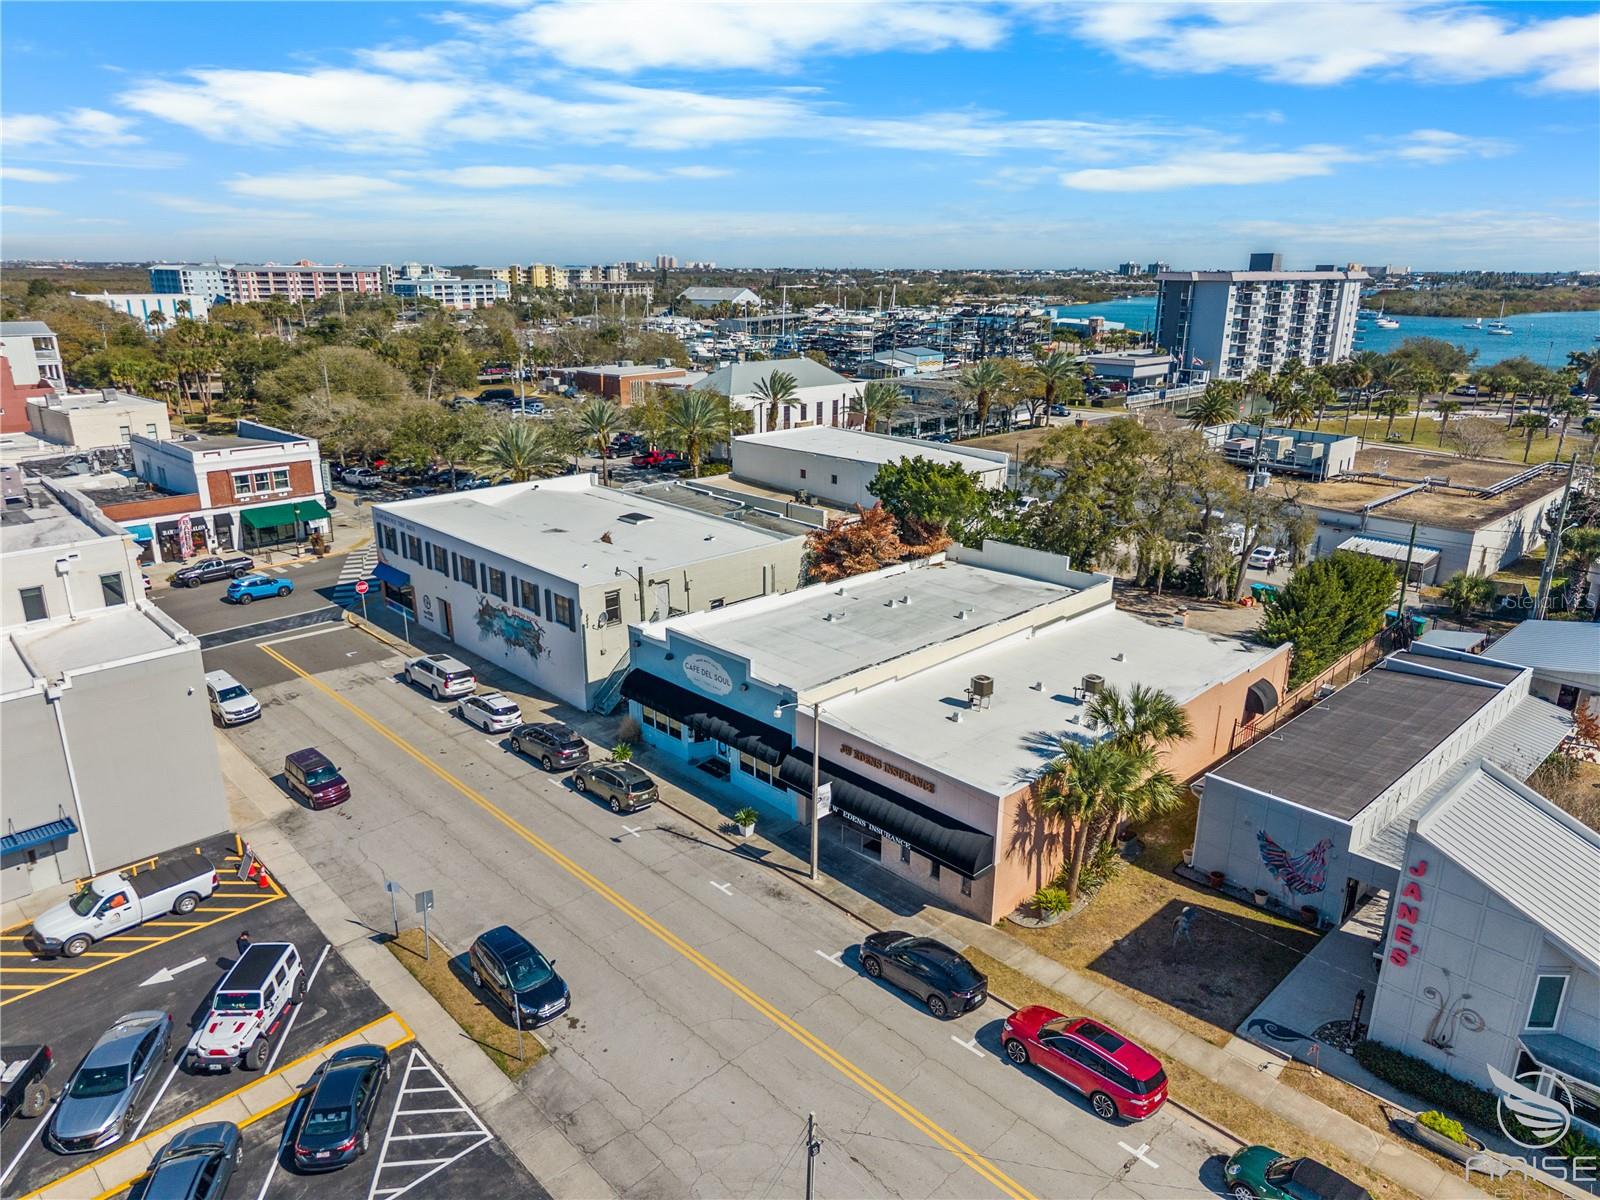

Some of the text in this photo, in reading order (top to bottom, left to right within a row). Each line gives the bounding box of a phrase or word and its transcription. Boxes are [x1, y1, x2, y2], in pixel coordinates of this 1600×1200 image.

[684, 662, 700, 674] CAFE
[701, 668, 713, 680] DEL
[714, 674, 731, 687] SOUL
[853, 749, 882, 769] EDENS
[883, 762, 936, 794] INSURANCE
[843, 810, 867, 828] EDENS
[1390, 860, 1428, 968] JANE'S
